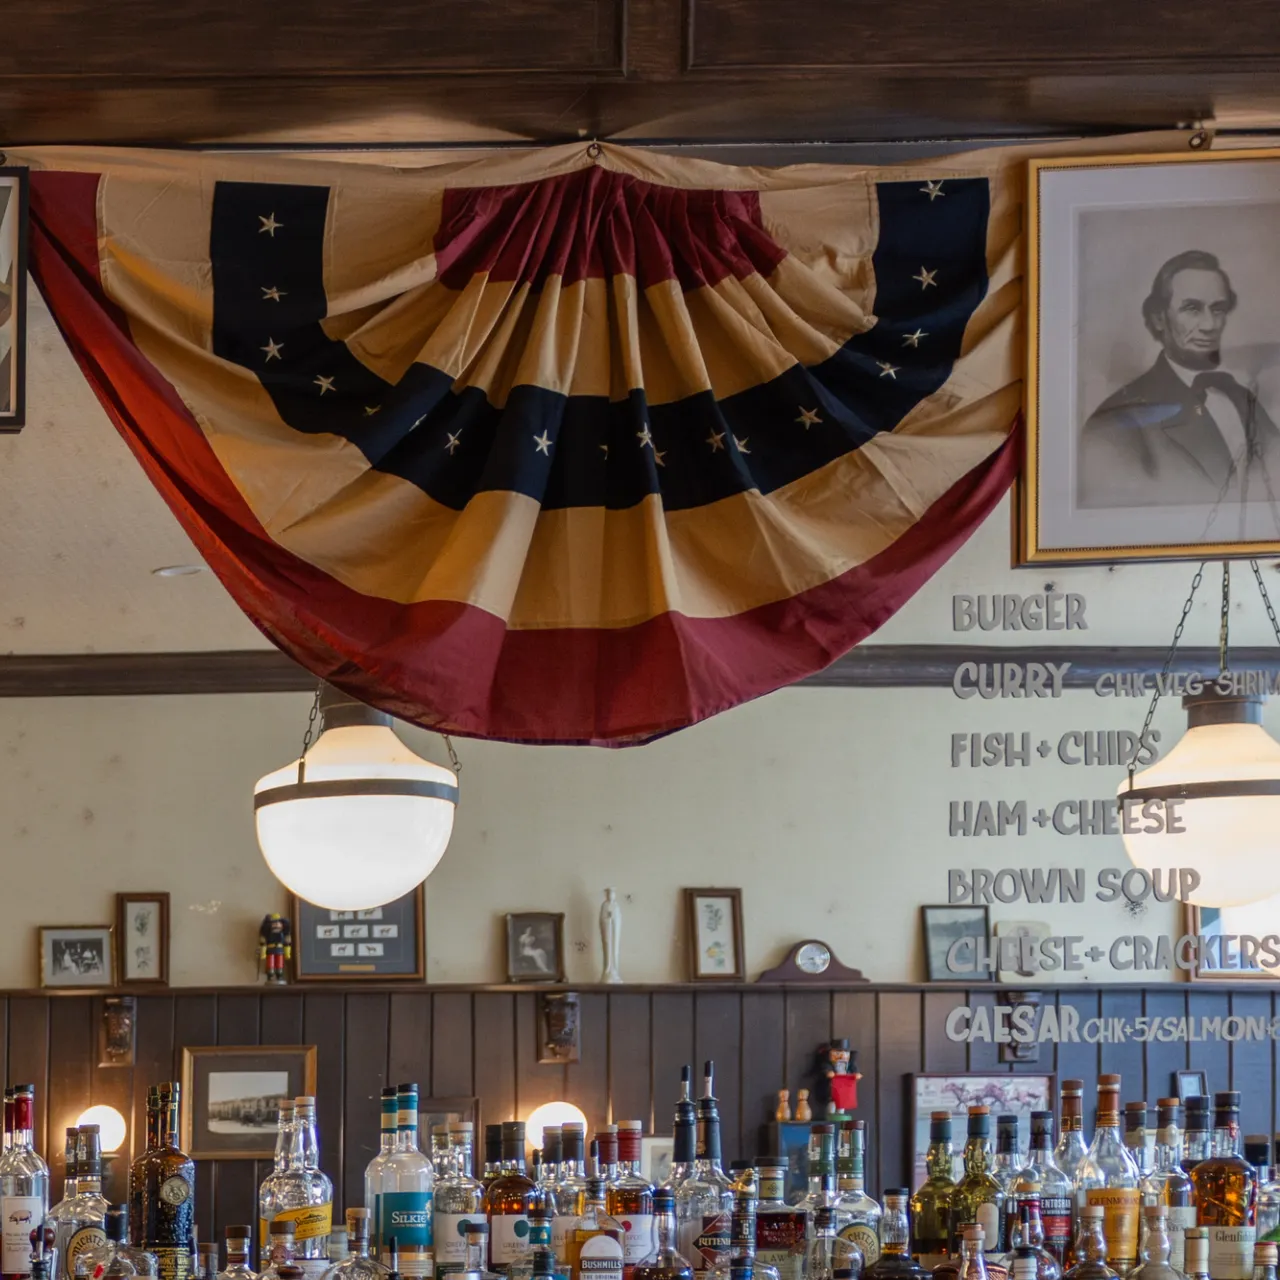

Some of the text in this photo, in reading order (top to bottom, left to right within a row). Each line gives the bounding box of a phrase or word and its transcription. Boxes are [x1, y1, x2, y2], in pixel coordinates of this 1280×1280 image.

[953, 593, 1089, 631] BURGER
[953, 661, 1071, 699] CURRY
[948, 867, 1201, 904] BROWN SOUP
[946, 1005, 1081, 1043] CAESAR
[742, 1223, 749, 1235] 6
[581, 1260, 622, 1269] BUSHMILLS
